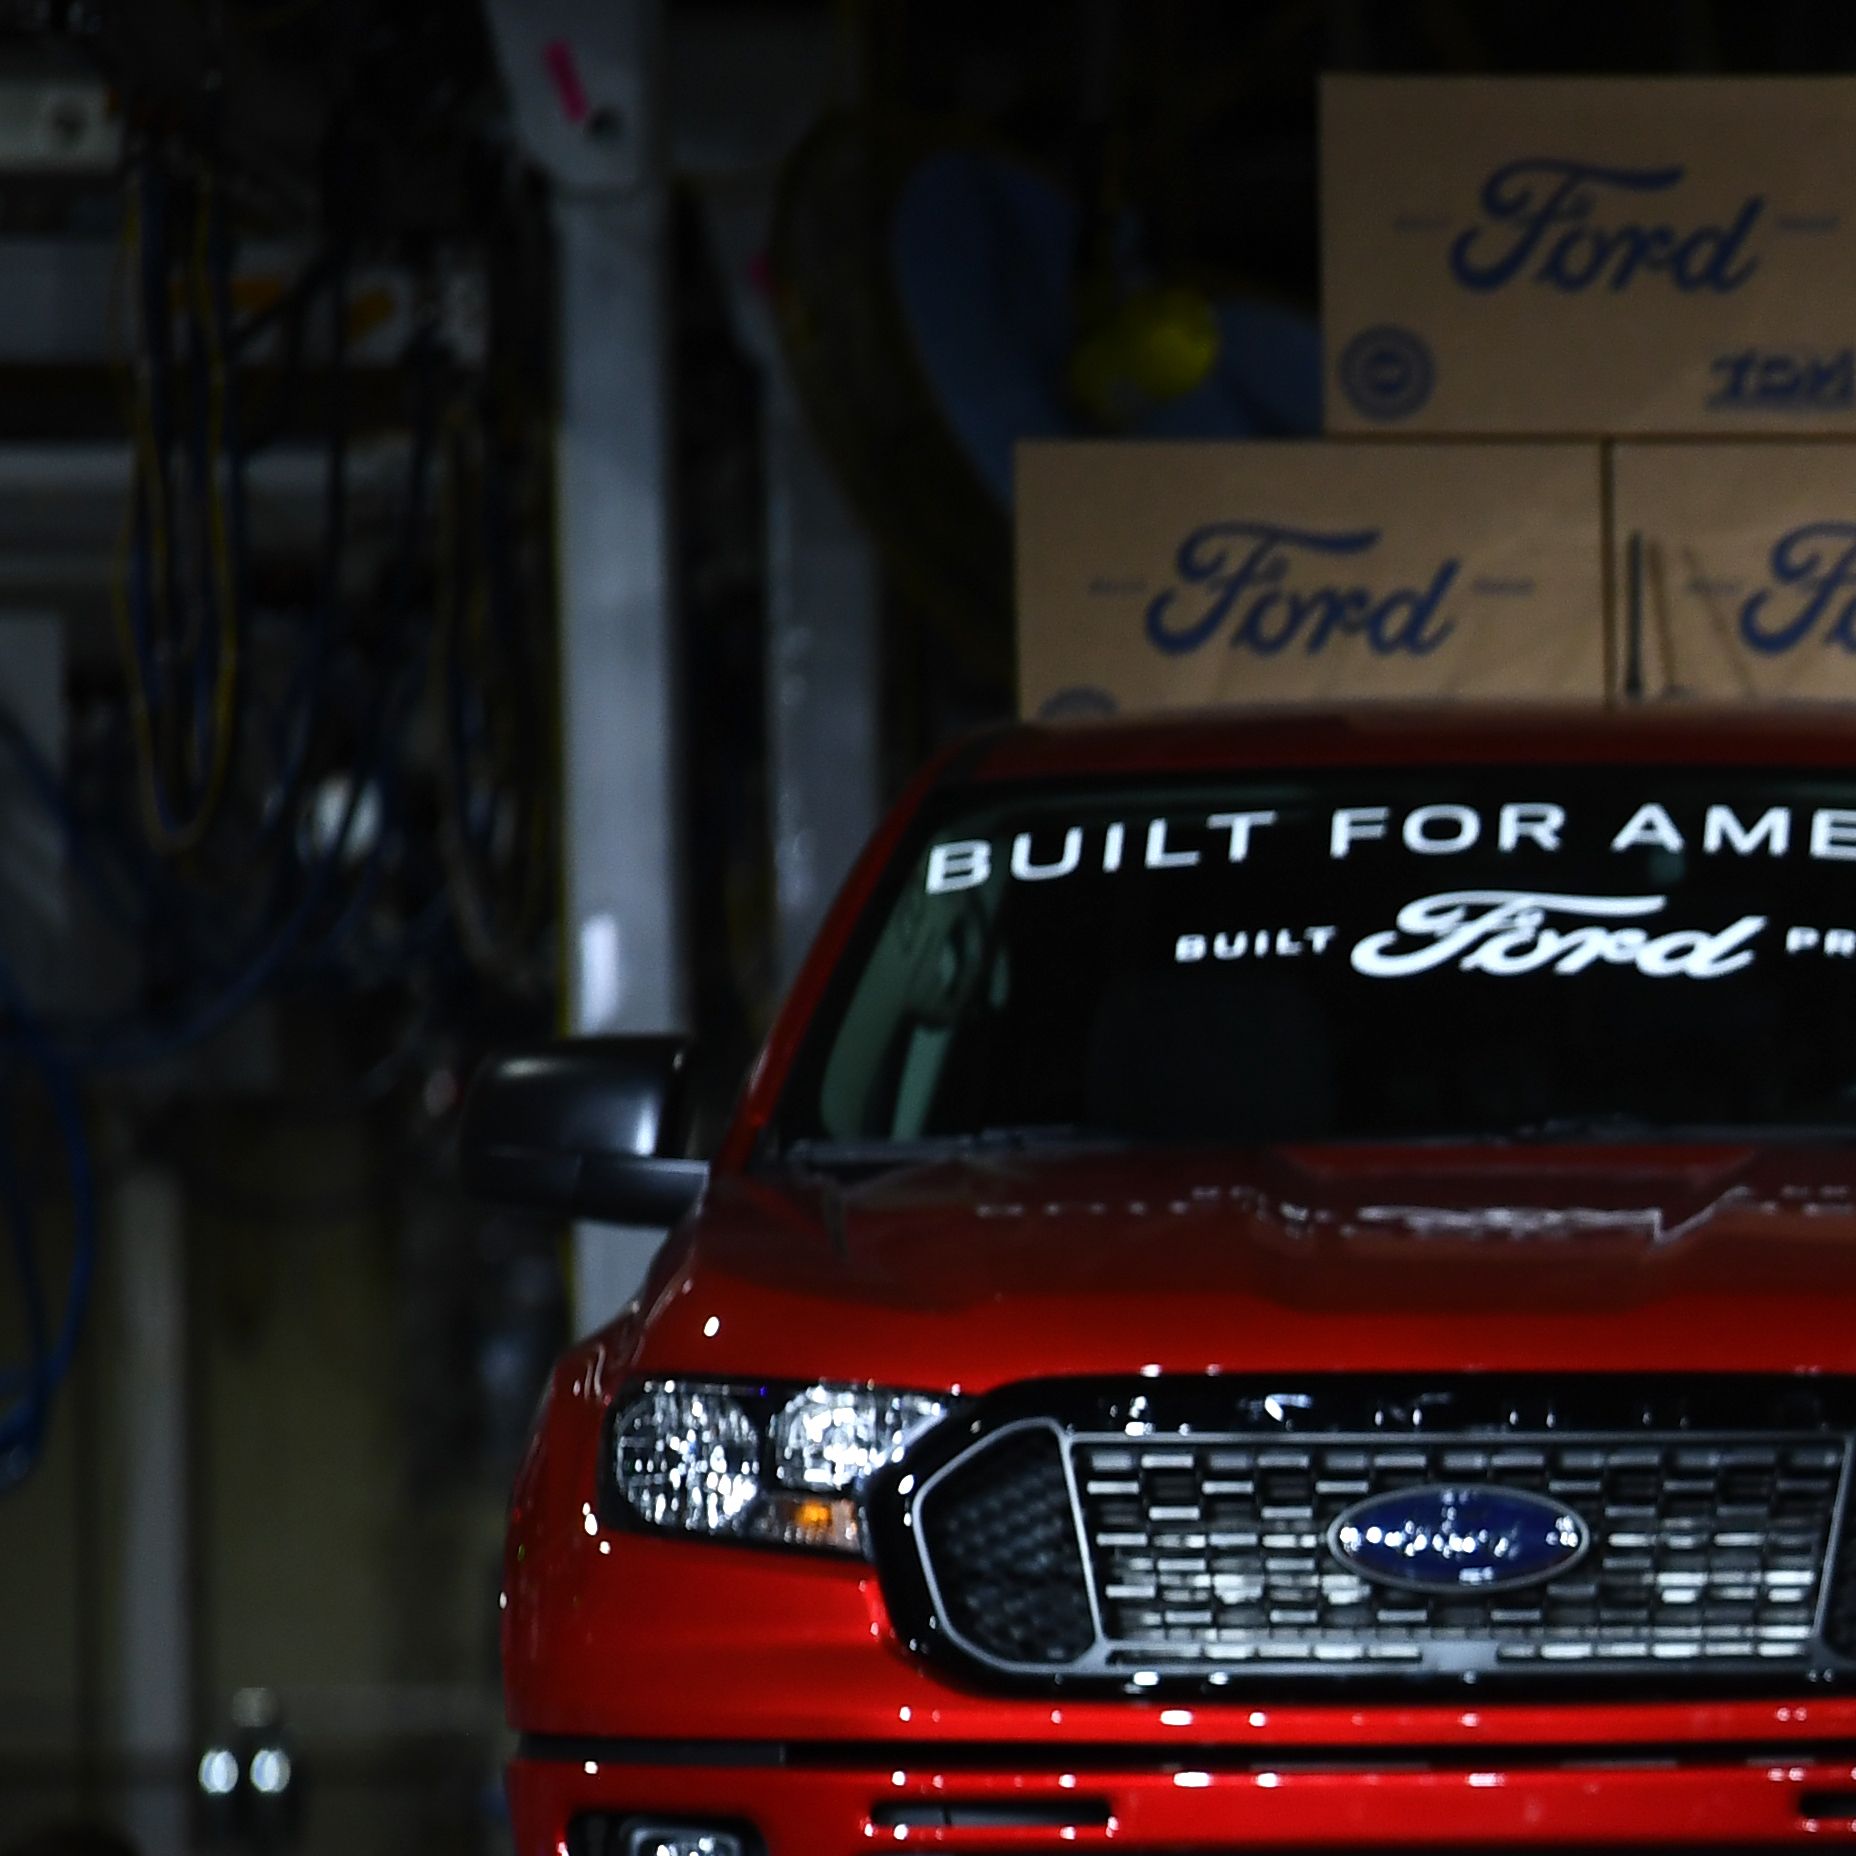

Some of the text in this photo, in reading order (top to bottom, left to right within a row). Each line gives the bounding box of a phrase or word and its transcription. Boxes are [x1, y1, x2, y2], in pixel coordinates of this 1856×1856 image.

[1447, 157, 1766, 294] Ford
[1142, 520, 1460, 658] Ford
[925, 809, 1277, 896] BUILT
[1328, 802, 1567, 859] FOR
[1174, 925, 1336, 962] BUILT
[1349, 889, 1767, 979] Ford
